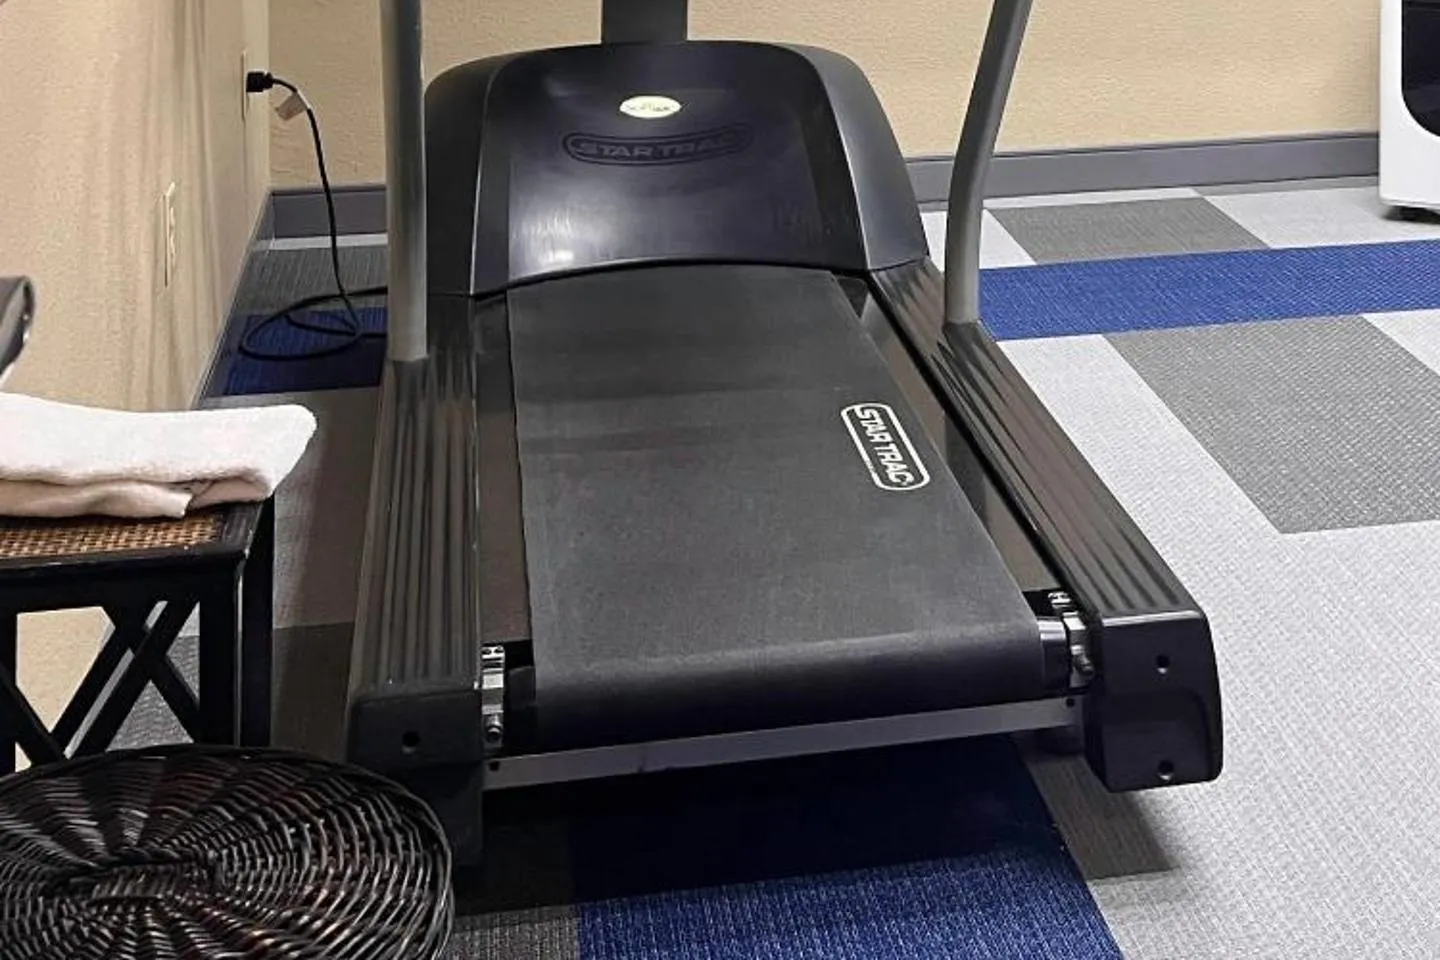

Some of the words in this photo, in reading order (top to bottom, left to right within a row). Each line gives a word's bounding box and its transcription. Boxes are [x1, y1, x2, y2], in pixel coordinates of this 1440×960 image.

[574, 141, 654, 158] STAR
[854, 406, 893, 443] STAR
[873, 442, 914, 486] TRAC
